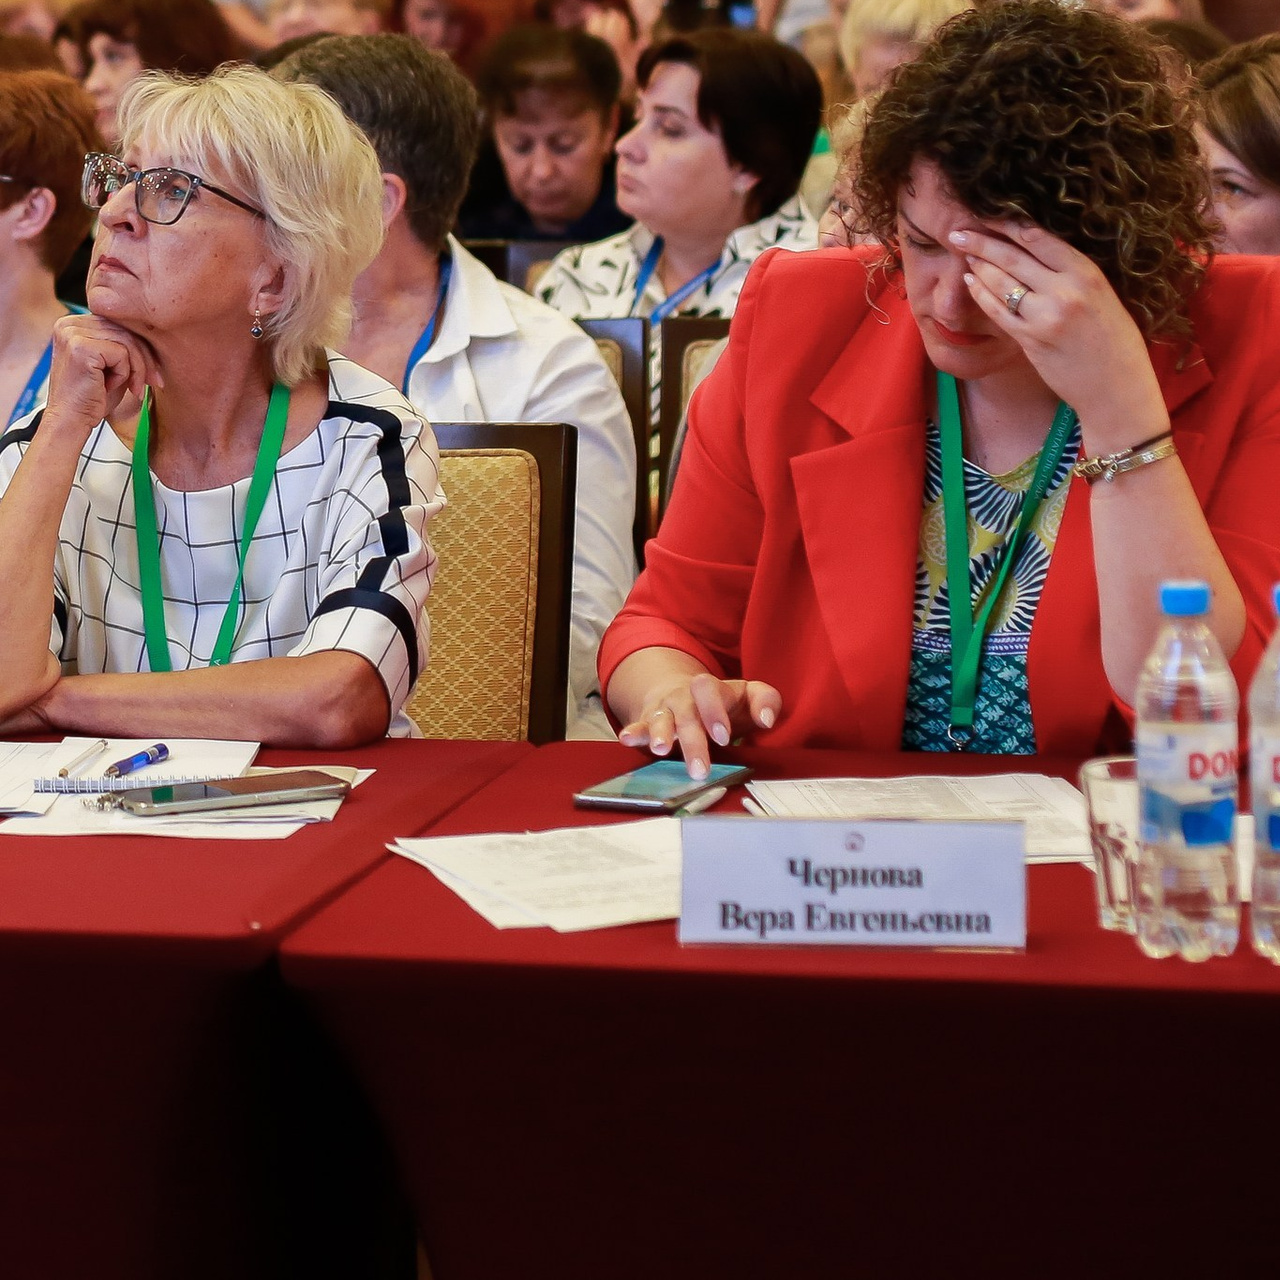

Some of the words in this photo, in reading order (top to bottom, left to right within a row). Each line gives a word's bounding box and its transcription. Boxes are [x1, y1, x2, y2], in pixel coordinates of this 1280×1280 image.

[786, 856, 924, 895] Чернова
[719, 901, 795, 938] Вера
[805, 903, 992, 935] Евгеньевна
